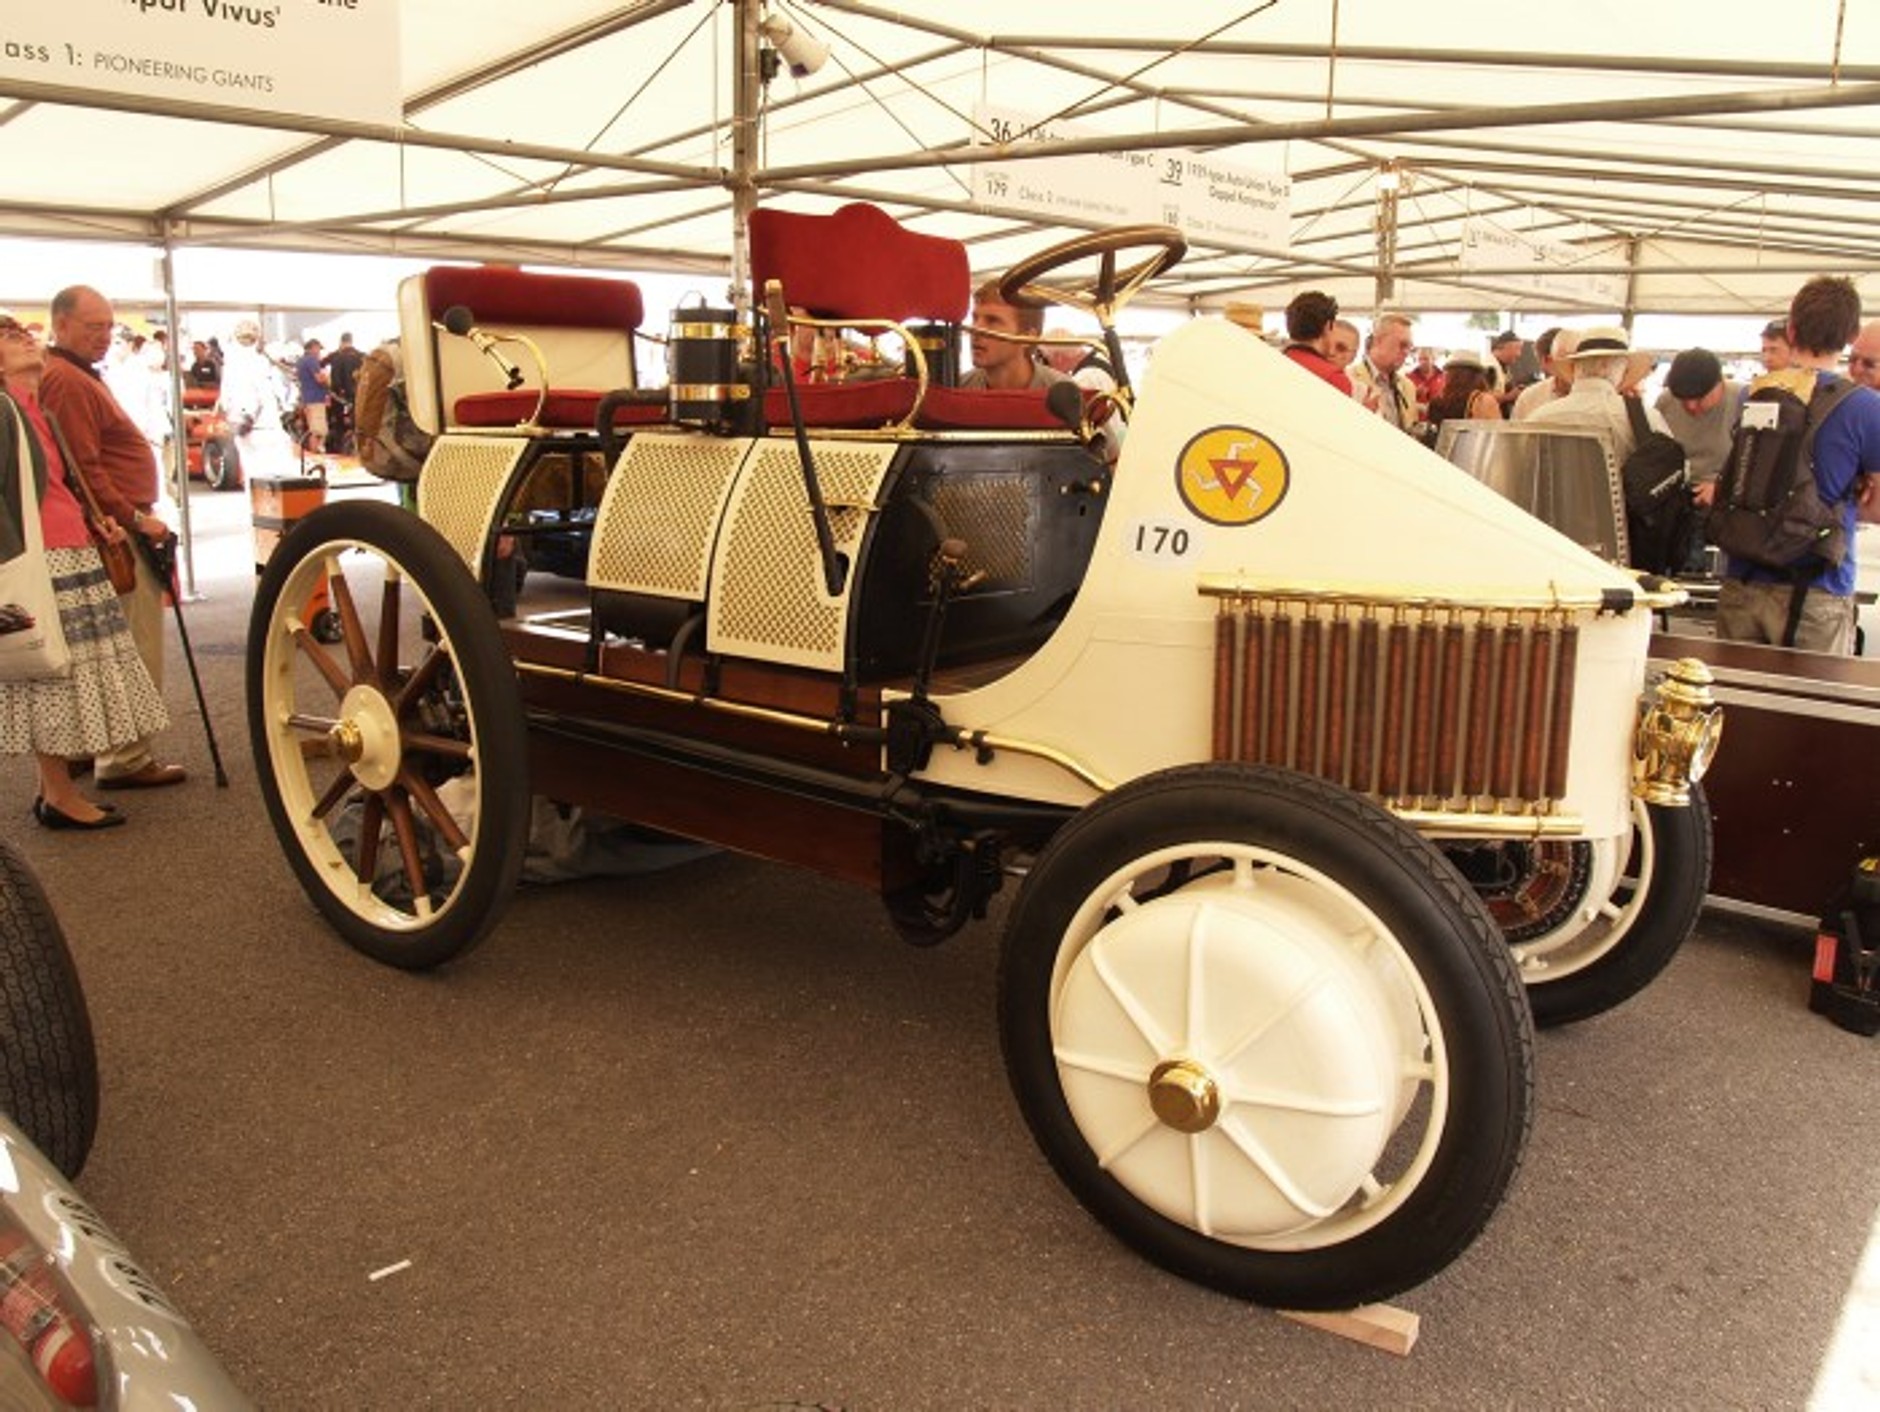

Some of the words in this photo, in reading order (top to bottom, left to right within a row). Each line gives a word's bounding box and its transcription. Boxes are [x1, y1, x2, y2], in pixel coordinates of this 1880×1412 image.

[64, 43, 82, 66] 1:
[94, 52, 208, 84] PIONEERING
[211, 69, 275, 93] GIANTS
[991, 118, 1012, 141] 36
[1165, 158, 1183, 181] 39
[986, 179, 1008, 198] 179
[1136, 526, 1189, 555] 170
